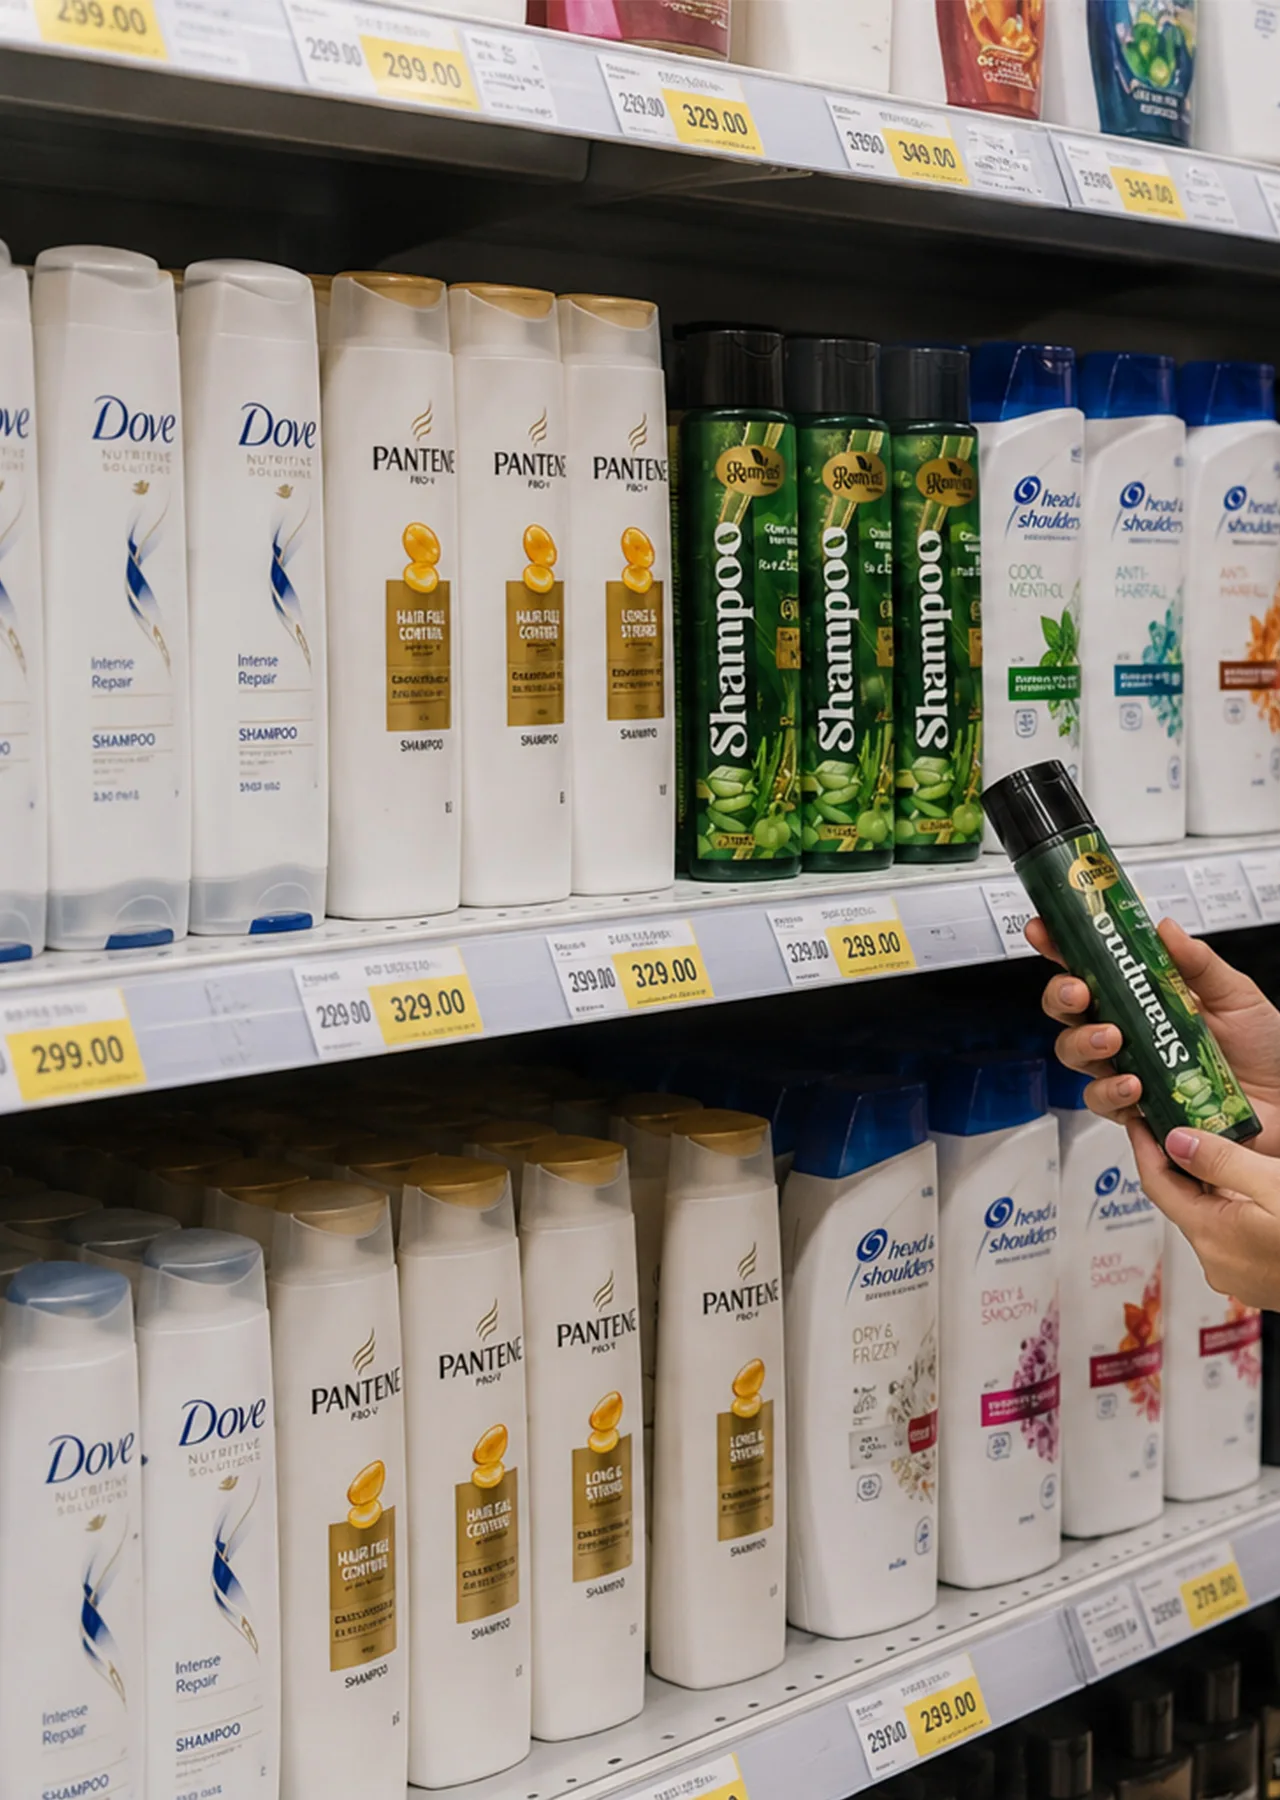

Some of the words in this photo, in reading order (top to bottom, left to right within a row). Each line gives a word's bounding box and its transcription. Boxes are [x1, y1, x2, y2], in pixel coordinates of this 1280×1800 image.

[382, 51, 462, 89] 299.00
[682, 103, 748, 135] 329.00
[92, 395, 176, 444] Dove
[238, 402, 317, 449] Dove
[709, 521, 754, 758] Shampoo
[818, 526, 860, 753] Shampoo
[915, 530, 952, 750] Shampoo
[91, 657, 135, 671] Intense
[238, 654, 279, 668] Intense
[92, 675, 133, 691] Repair
[238, 671, 277, 687] Repair
[92, 733, 156, 749] SHAMPOO
[239, 727, 298, 742] SHAMPOO
[631, 957, 698, 988] 329.00
[390, 988, 465, 1023] 329.00
[31, 1034, 125, 1075] 299.00
[438, 1335, 524, 1380] PANTENE
[311, 1366, 402, 1415] PANTENE
[179, 1398, 266, 1447] Dove
[45, 1432, 134, 1484] Dove
[175, 1653, 221, 1675] Intense
[176, 1672, 219, 1694] Repair
[42, 1704, 89, 1727] Intense
[42, 1724, 87, 1746] Repair
[176, 1722, 241, 1752] SHAMPOO
